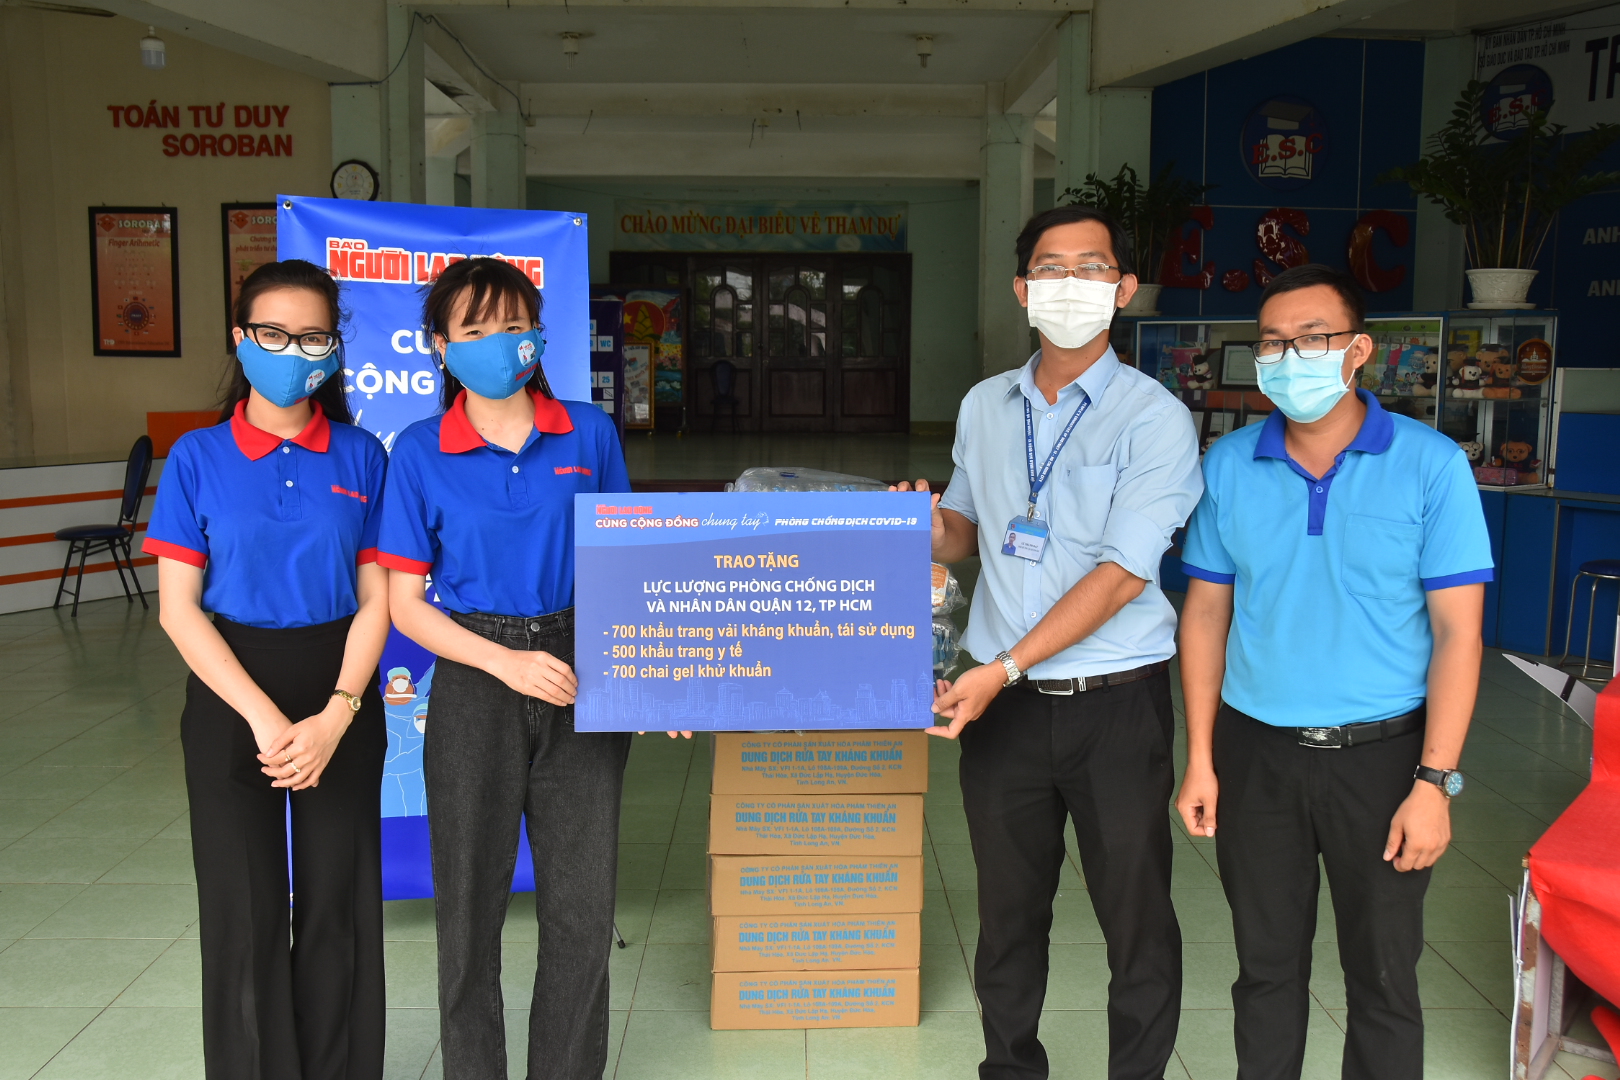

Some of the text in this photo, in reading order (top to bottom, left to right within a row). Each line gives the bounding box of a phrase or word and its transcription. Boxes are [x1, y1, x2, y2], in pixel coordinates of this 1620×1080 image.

[1492, 34, 1503, 49] BAN
[107, 100, 290, 128] TOÁN TƯ DUY
[162, 132, 293, 158] SOROBAN
[1251, 132, 1324, 165] E.S.C
[620, 210, 902, 241] CHÀO MỪNG ĐẠI BIỂU VỀ THAM DỰ
[108, 238, 129, 248] Finger
[329, 249, 410, 282] NGƯỜI
[1586, 279, 1620, 297] AN
[600, 340, 612, 348] WC
[602, 376, 611, 384] 25
[595, 514, 700, 530] CÙNG CỘNG ĐỒNG
[701, 512, 761, 530] chung tay
[774, 514, 918, 527] PHÒNG CHỐNG DỊCH COVID-19
[714, 551, 800, 571] TRAO TẶNG
[643, 576, 874, 596] LỰC LƯỢNG PHÒNG CHỐNG DỊCH
[646, 597, 872, 615] VÀ NHÂN DÂN QUẬN 12, TP HCM
[612, 624, 637, 638] 700
[640, 621, 674, 638] khẩu
[677, 625, 714, 641] trang
[717, 622, 738, 638] vải
[741, 623, 784, 641] kháng
[787, 620, 834, 639] khuẩn,
[837, 622, 855, 637] tái
[858, 622, 878, 637] sử
[880, 622, 916, 640] dụng
[612, 644, 637, 658] 500
[640, 640, 674, 658] khẩu
[677, 645, 715, 661] trang
[717, 647, 726, 661] y
[729, 640, 743, 657] tế
[612, 664, 637, 678] 700
[640, 664, 670, 678] chai
[673, 664, 695, 680] gel
[698, 663, 727, 677] khử
[729, 660, 772, 677] khuẩn
[741, 745, 903, 764] DUNG DỊCH RỬA TAY KHÁNG KHUẨN
[735, 806, 896, 825] DUNG DỊCH RỬA TAY KHÁNG KHUẨN
[740, 867, 898, 888] DUNG DỊCH RỬA TAY KHÁNG KHUẨN
[739, 924, 896, 945] DUNG DỊCH RỬA TAY KHÁNG KHUẨN
[739, 982, 896, 1003] DUNG DỊCH RỬA TAY KHÁNG KHUẨN
